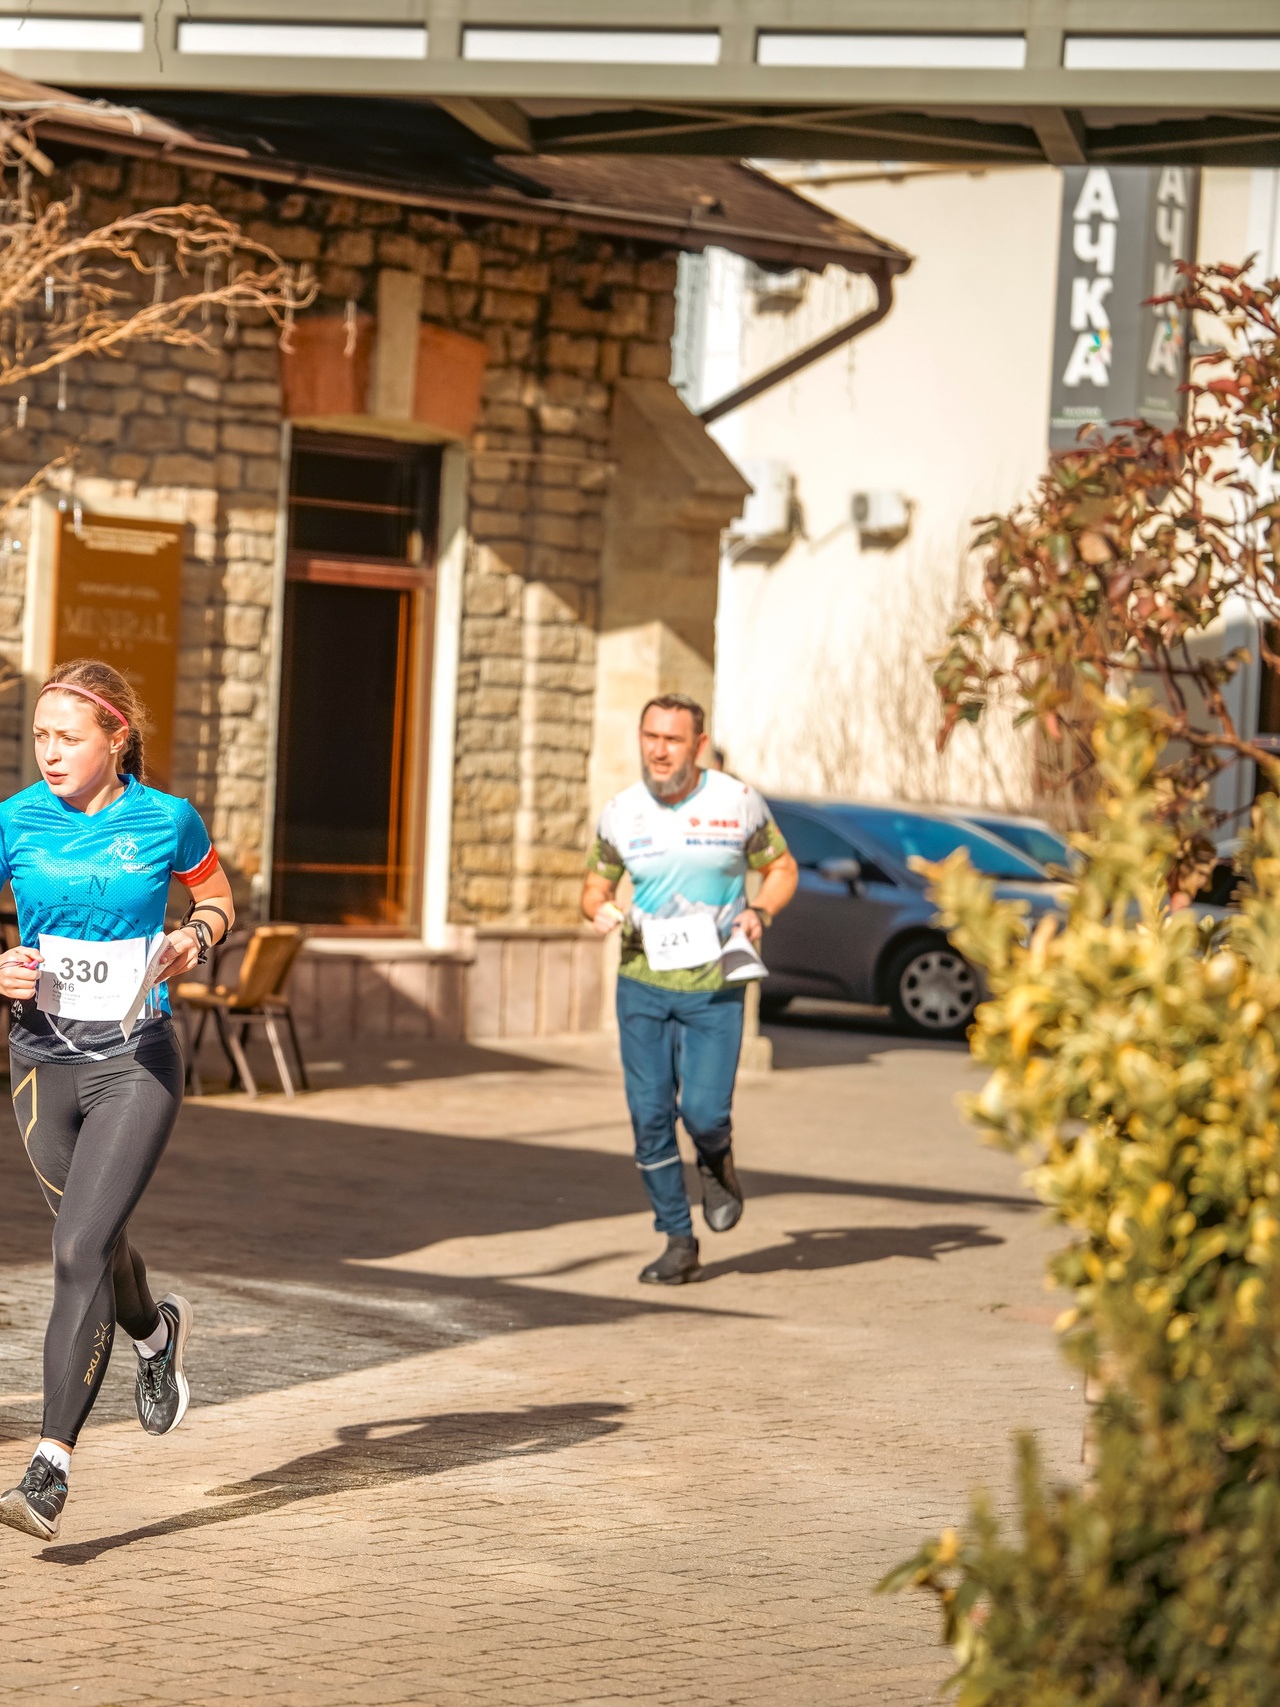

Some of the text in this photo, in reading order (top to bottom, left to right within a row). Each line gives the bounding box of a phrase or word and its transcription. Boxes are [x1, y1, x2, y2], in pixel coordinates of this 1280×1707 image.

[660, 931, 690, 947] 221
[59, 957, 109, 984] 330
[83, 1350, 101, 1386] 2XU
